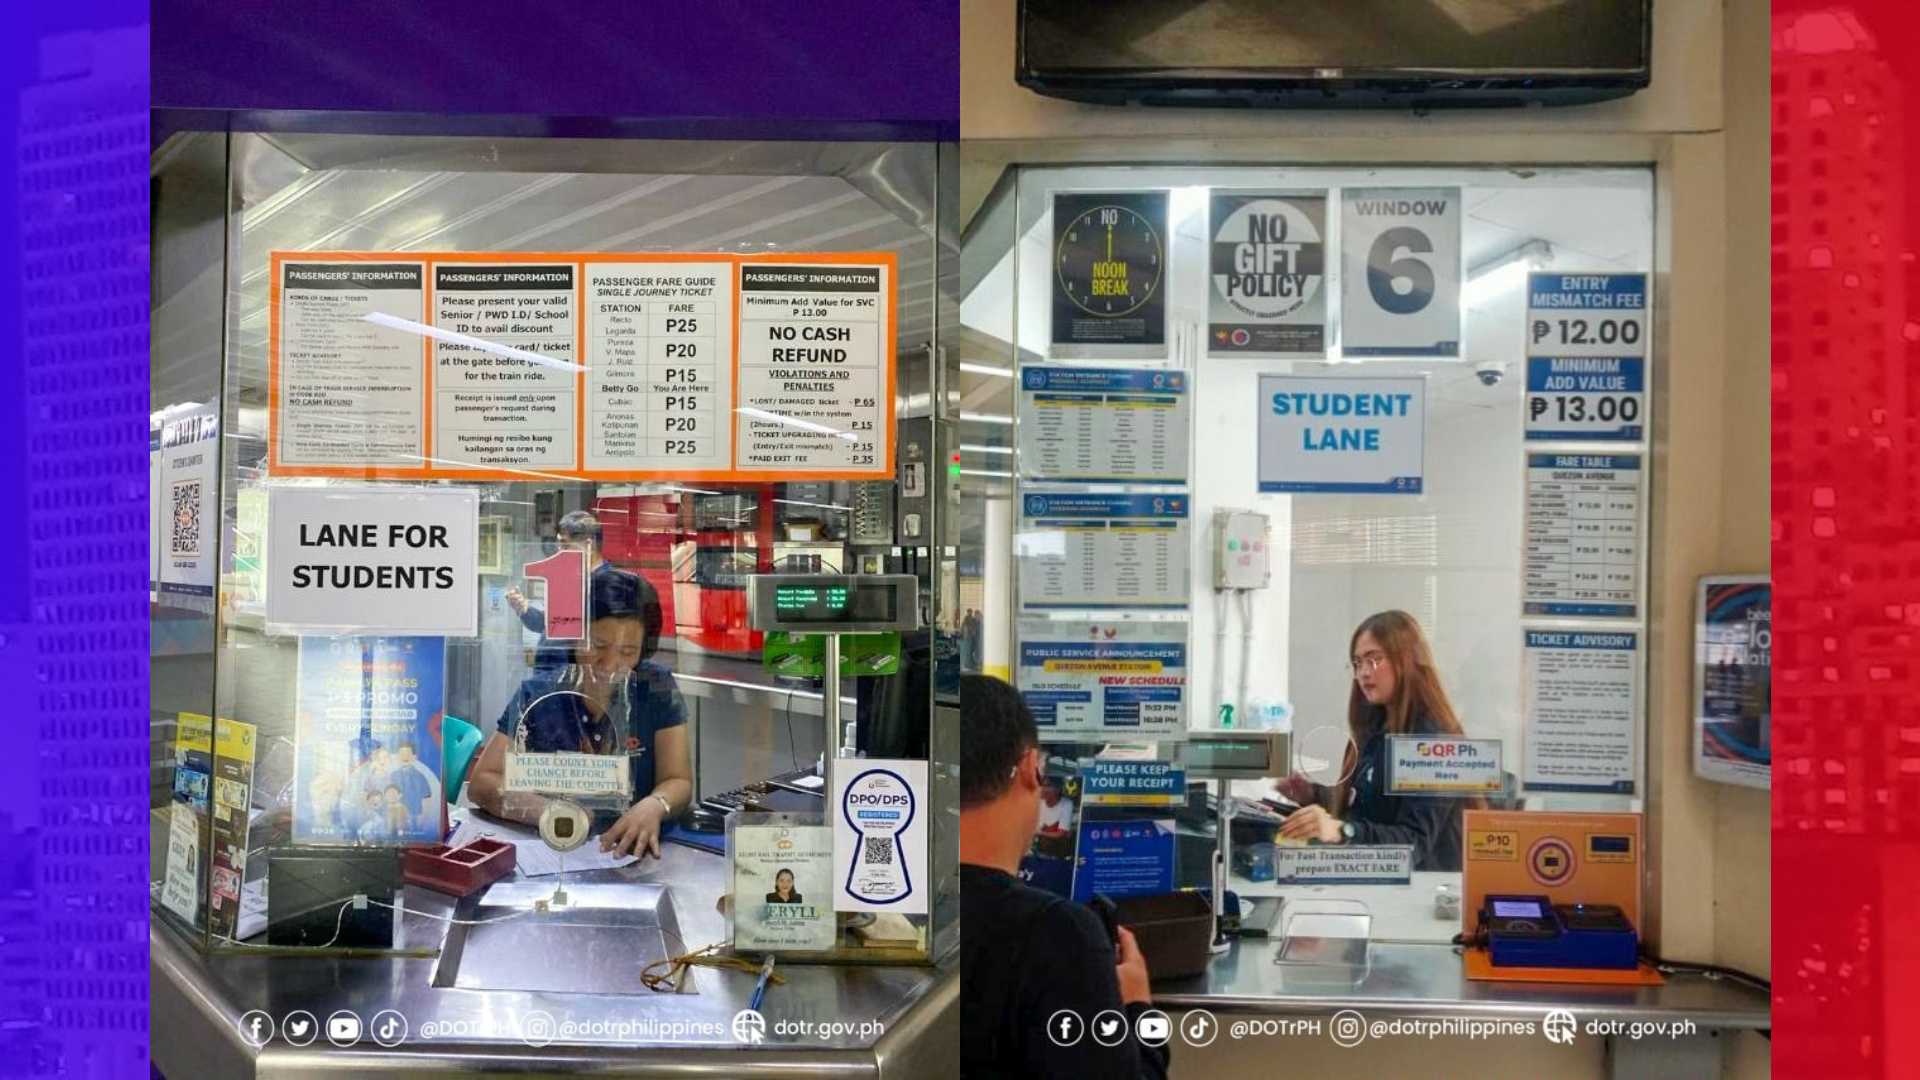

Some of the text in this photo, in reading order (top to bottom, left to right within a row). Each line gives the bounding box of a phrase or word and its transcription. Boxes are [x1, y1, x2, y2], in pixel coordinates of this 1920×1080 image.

[1354, 200, 1447, 217] WINDOW
[1101, 209, 1118, 225] NO
[1249, 214, 1288, 243] NO
[1234, 243, 1302, 274] GIFT
[1093, 262, 1126, 278] NOON
[1366, 226, 1435, 315] 6
[289, 272, 417, 280] PASSENGERS' INFORMATION
[440, 273, 569, 282] PASSENGERS' INFORMATION
[746, 274, 875, 283] PASSENGERS' INFORMATION
[593, 278, 716, 286] PASSENGER FARE GUIDE
[1092, 279, 1128, 295] BREAK
[1227, 274, 1308, 297] POLICY
[1561, 276, 1609, 290] ENTRY
[597, 288, 712, 297] SINGLE JOURNEY TICKET
[442, 297, 567, 307] Please present your valid
[747, 297, 788, 305] Minimum
[1532, 293, 1642, 308] MISMATCH FEE
[601, 304, 694, 313] STATION FARE
[802, 309, 827, 317] 13.00
[441, 311, 473, 319] Senior
[485, 311, 508, 319] PWD
[535, 311, 569, 319] School
[485, 324, 508, 332] avail
[511, 324, 553, 333] discount
[666, 319, 697, 332] P25
[769, 327, 851, 341] NO CASH
[1558, 319, 1640, 344] 12.00
[439, 343, 471, 351] Please
[543, 343, 570, 351] ticket
[666, 344, 696, 358] P20
[773, 348, 847, 363] REFUND
[472, 358, 492, 367] gate
[495, 358, 525, 366] before
[1551, 359, 1620, 373] MINIMUM
[666, 369, 697, 382] P15
[769, 370, 849, 380] VIOLATIONS AND
[784, 382, 835, 392] PENALTIES
[1545, 376, 1626, 390] ADD VALUE
[602, 385, 624, 393] Betty
[455, 394, 483, 402] Receipt
[519, 394, 535, 402] only
[666, 397, 697, 410] P15
[1272, 393, 1412, 417] STUDENT
[1556, 396, 1638, 422] 13.00
[666, 418, 696, 431] P20
[861, 422, 873, 430] 15
[1303, 428, 1381, 451] LANE
[666, 441, 696, 454] P25
[862, 443, 873, 451] 15
[1555, 456, 1612, 468] FARE TABLE
[299, 524, 449, 549] LANE FOR
[292, 565, 454, 590] STUDENTS
[524, 550, 586, 640] 1
[1530, 633, 1632, 648] TICKET ADVISORY
[1102, 650, 1180, 658] ANNOUNCEMENT
[1098, 677, 1186, 685] NEW SCHEDULE
[355, 692, 418, 705] PROMO
[1431, 744, 1478, 756] QR Ph
[515, 757, 616, 768] PLEASE COUNT YOUR
[1399, 759, 1495, 770] Payment Accepted
[527, 768, 606, 778] CHANGE BEFORE
[1095, 764, 1169, 775] PLEASE KEEP
[1435, 772, 1458, 780] Here
[510, 778, 551, 787] LEAVING
[1090, 777, 1175, 788] YOUR RECEIPT
[849, 794, 908, 805] DPO/DPS
[1486, 835, 1510, 846] P10
[1280, 851, 1407, 862] For Fast Transaction kindly
[1295, 864, 1400, 875] prepare EXACT FARE
